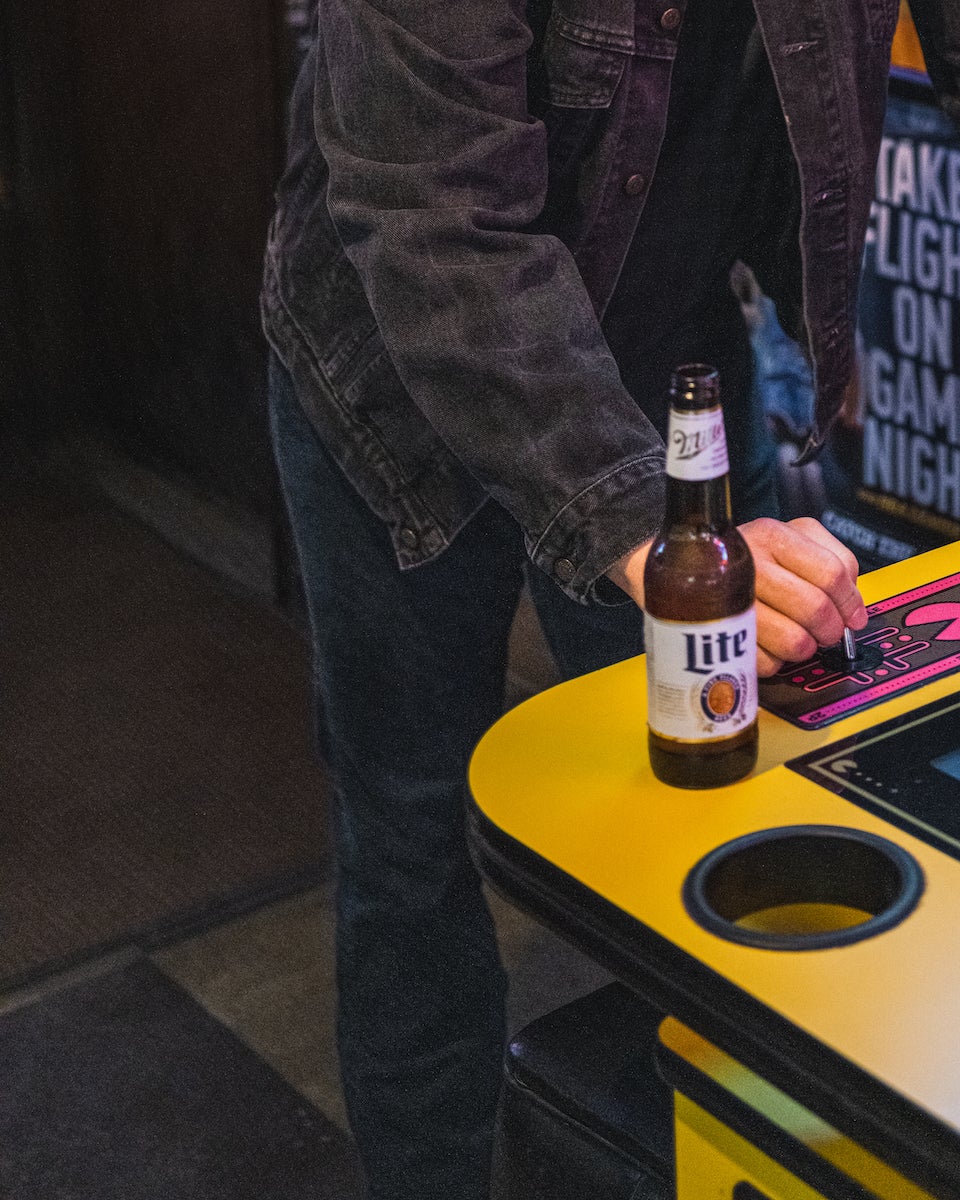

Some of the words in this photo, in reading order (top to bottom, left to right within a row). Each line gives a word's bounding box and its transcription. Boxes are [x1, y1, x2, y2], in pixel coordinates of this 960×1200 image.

[894, 287, 952, 370] ON
[683, 629, 747, 675] Lite
[808, 709, 827, 720] 2P
